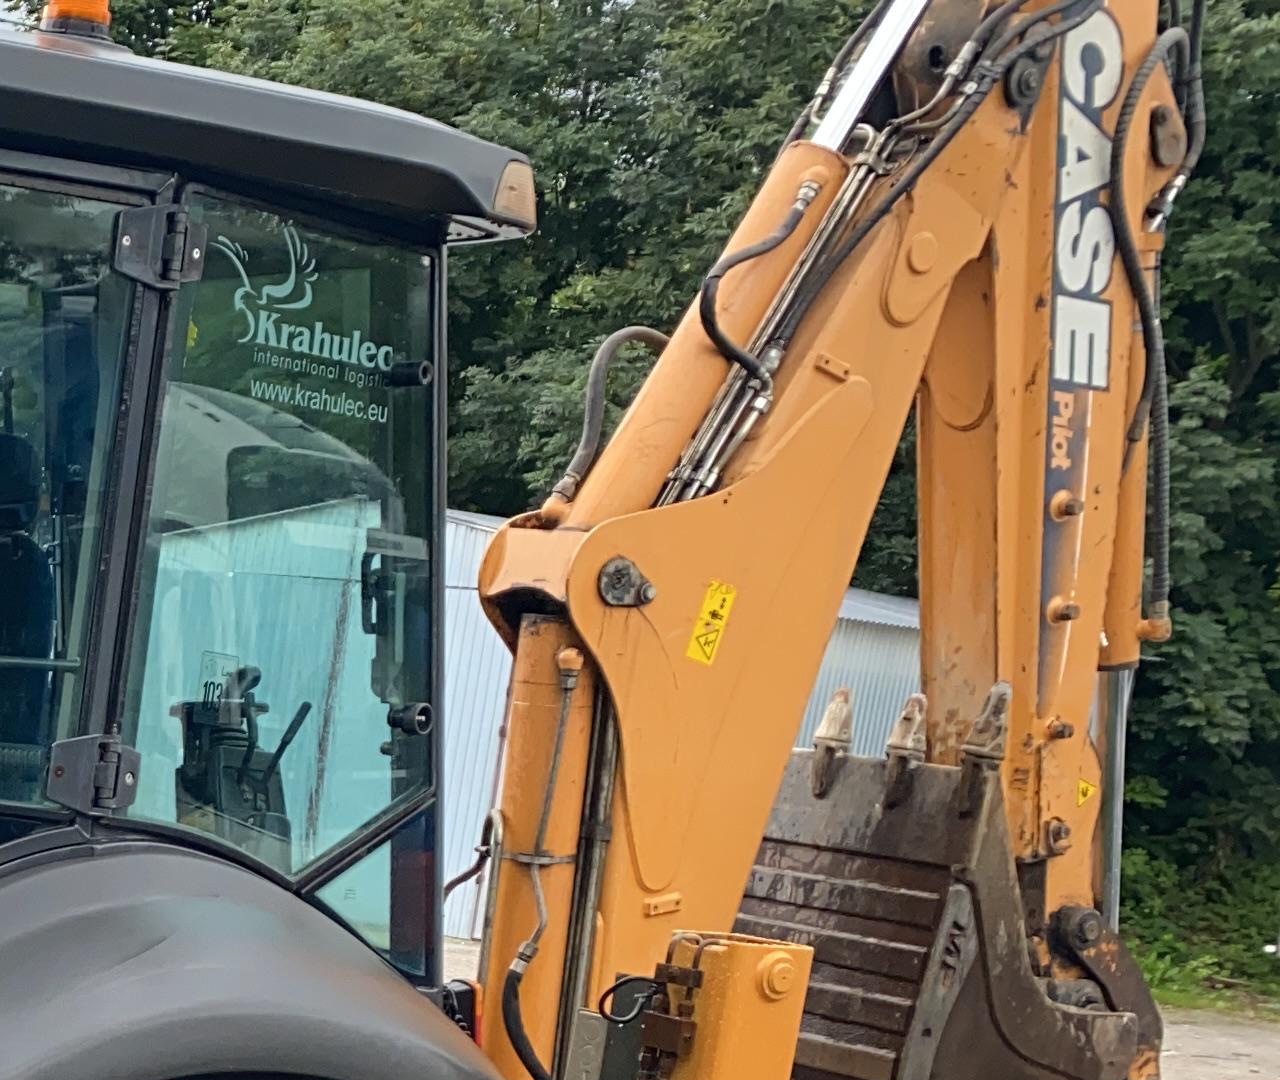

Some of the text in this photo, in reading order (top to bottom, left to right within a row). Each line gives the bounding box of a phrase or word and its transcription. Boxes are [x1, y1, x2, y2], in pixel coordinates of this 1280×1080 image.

[1053, 9, 1123, 388] CASE
[253, 348, 340, 379] international
[255, 309, 394, 372] Krahulec
[250, 379, 389, 423] www.krahulec.eu
[1050, 391, 1075, 470] Pilot
